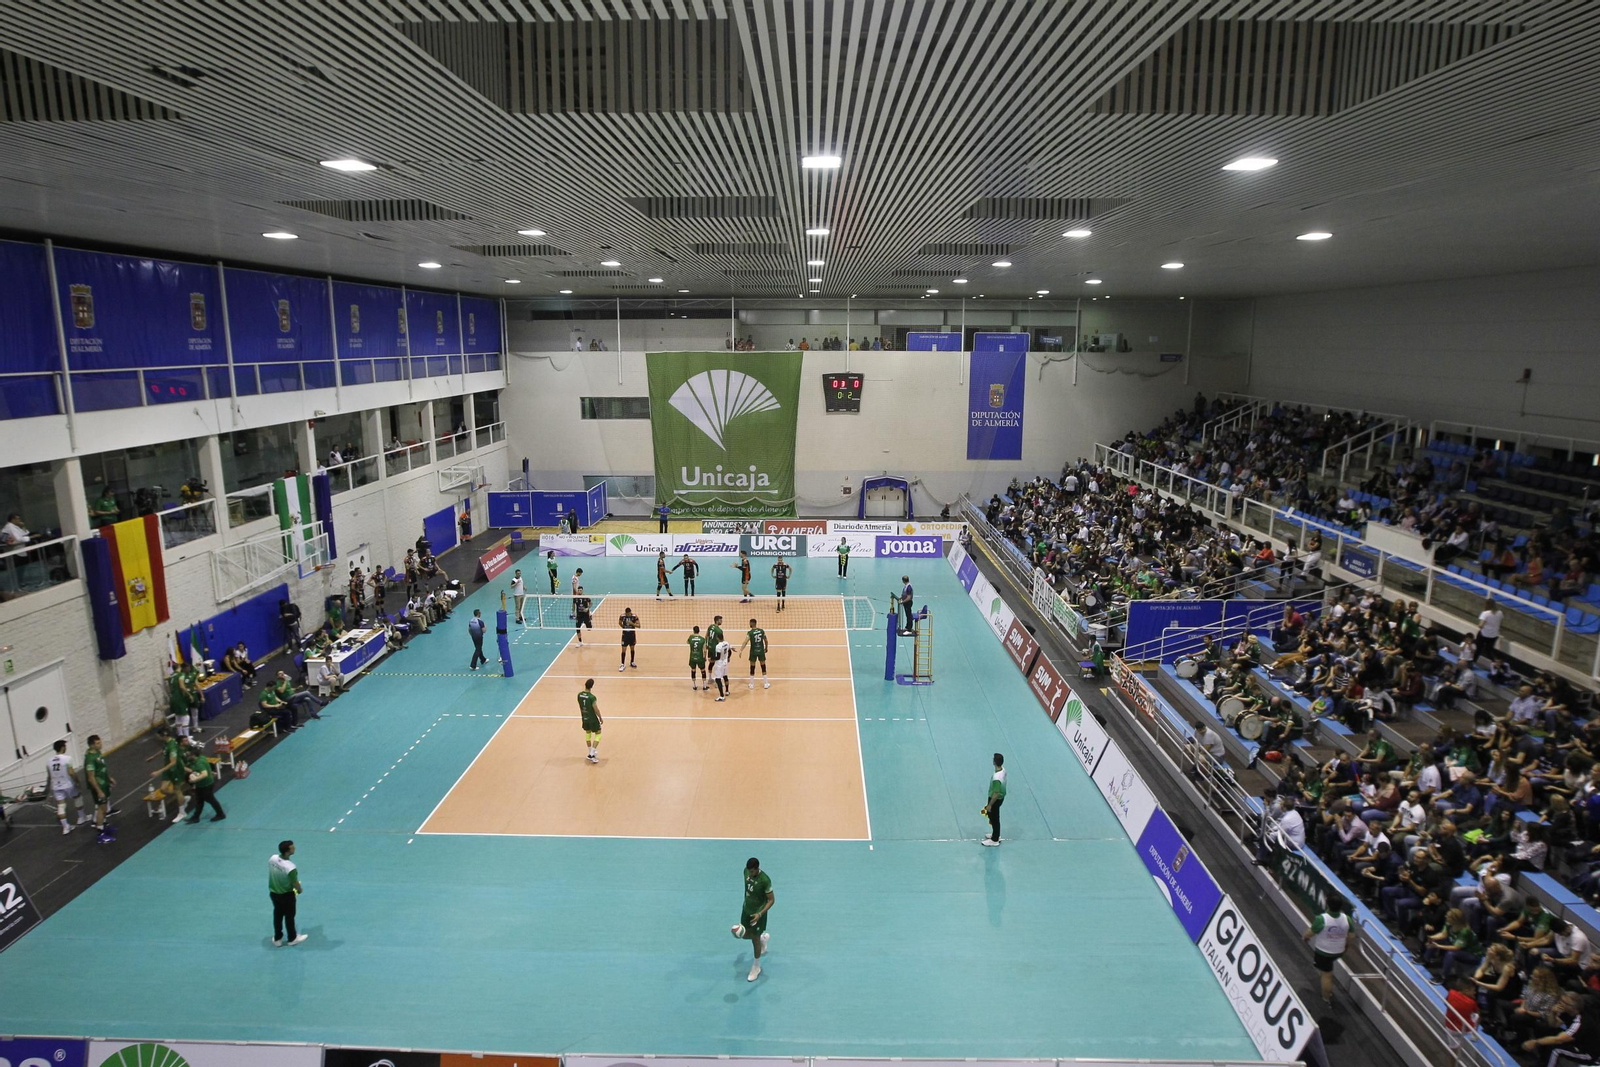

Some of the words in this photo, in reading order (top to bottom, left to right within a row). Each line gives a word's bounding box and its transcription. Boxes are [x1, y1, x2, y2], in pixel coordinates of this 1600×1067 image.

[972, 410, 1020, 418] DIPUTACIÓN
[984, 418, 1020, 426] ALMERÍA
[681, 464, 770, 492] Unicaja
[750, 536, 796, 550] URCI
[780, 526, 824, 534] ALMERÍA
[636, 544, 668, 552] Unicaja
[1073, 730, 1094, 766] Unicaja
[1148, 845, 1172, 880] DIPUTACIÓN
[1174, 885, 1193, 914] ALMERÍA
[1203, 938, 1232, 987] ITALIAN
[1216, 909, 1304, 1050] GLOBUS
